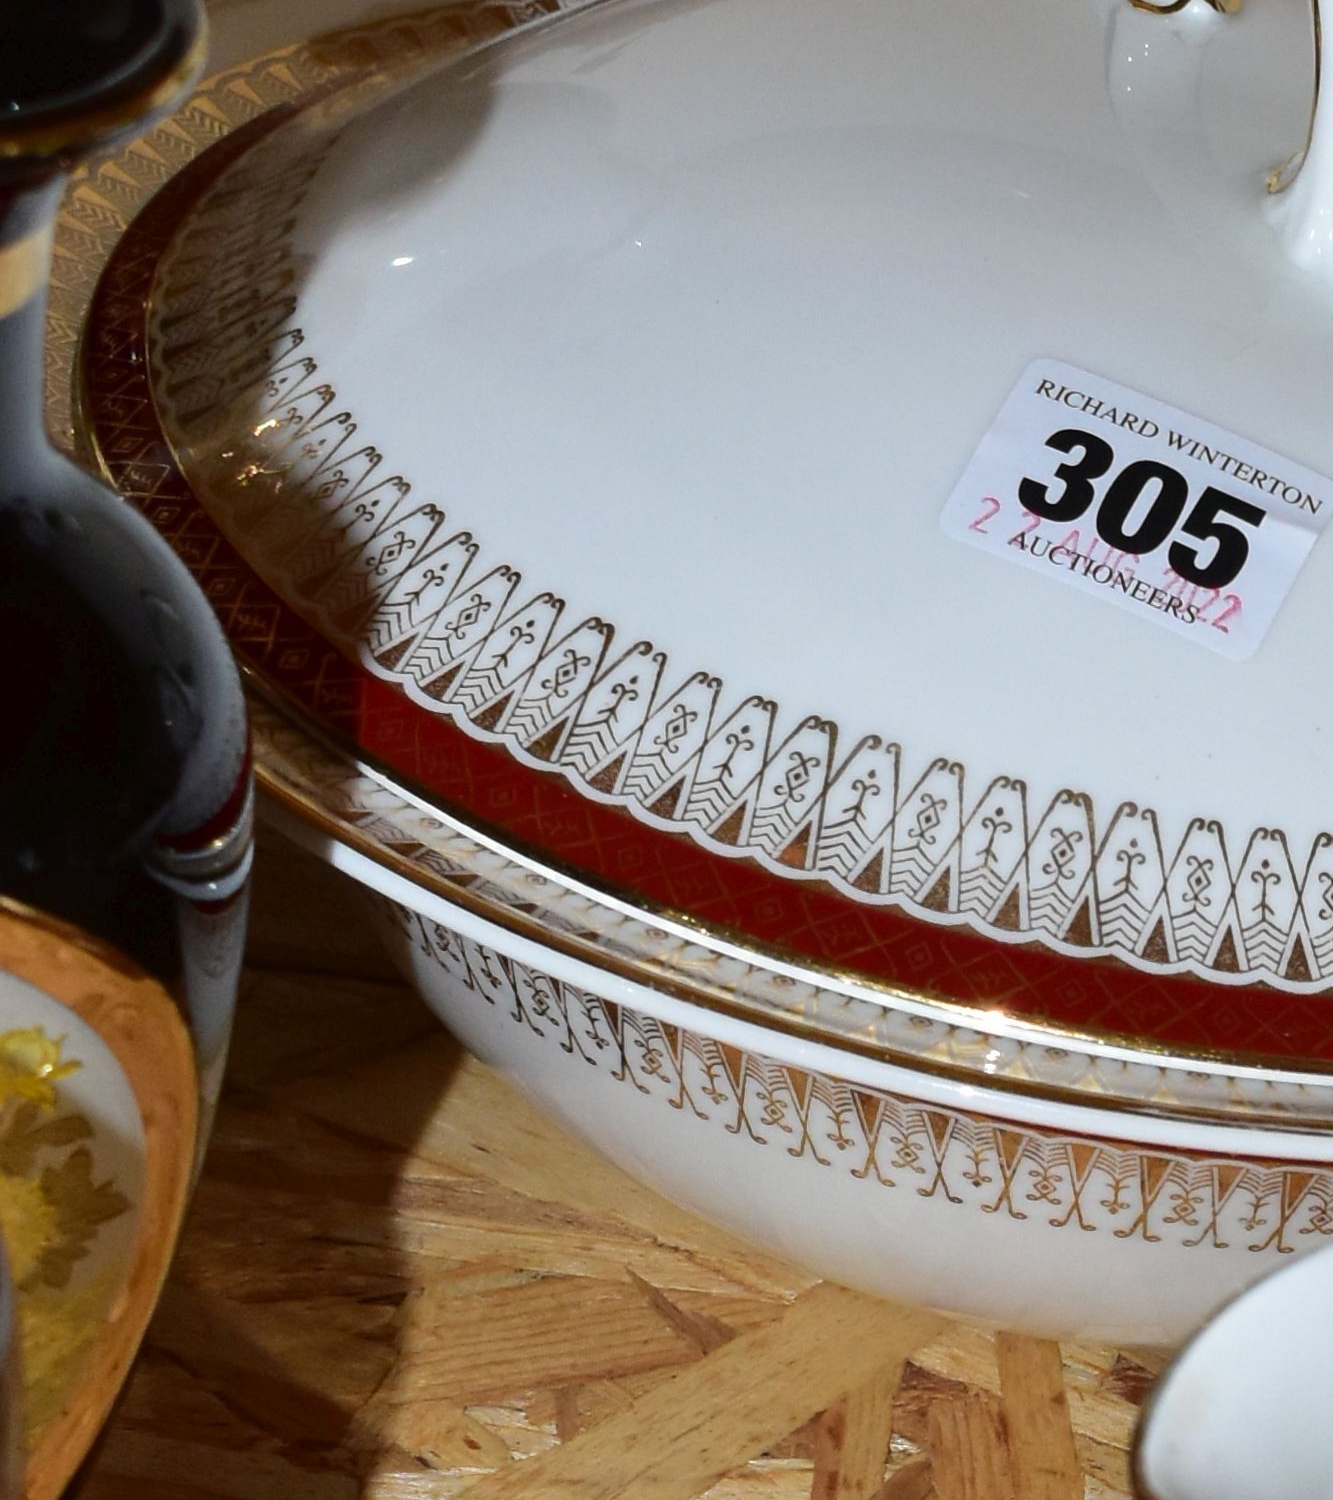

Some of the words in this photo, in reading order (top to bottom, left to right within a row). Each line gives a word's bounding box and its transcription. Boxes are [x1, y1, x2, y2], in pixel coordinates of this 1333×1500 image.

[1018, 429, 1266, 590] 305
[1034, 379, 1159, 438] RICHARD
[1168, 431, 1323, 515] WINTERTON
[1007, 531, 1199, 625] AUCTIONEERS
